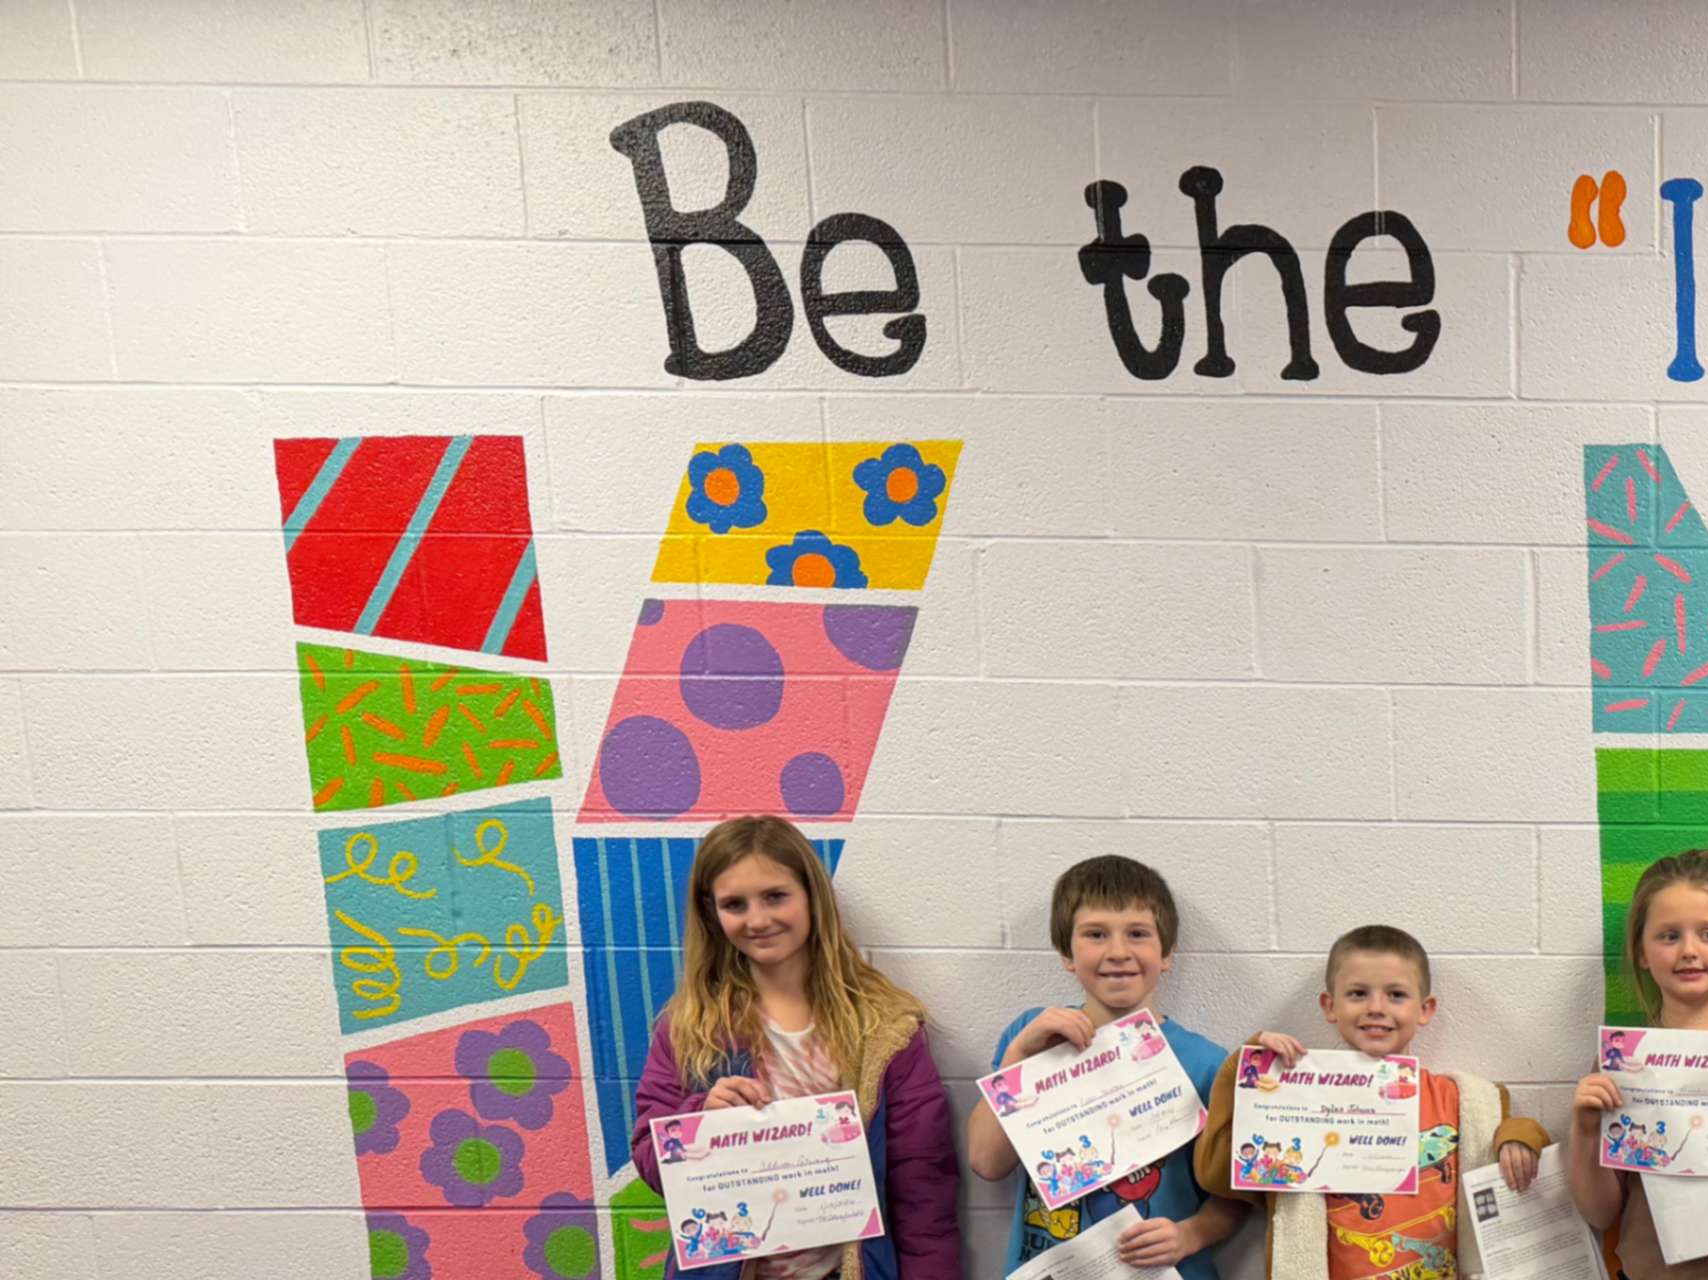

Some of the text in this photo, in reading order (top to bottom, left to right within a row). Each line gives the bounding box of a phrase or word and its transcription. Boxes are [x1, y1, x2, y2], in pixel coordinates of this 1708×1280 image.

[610, 101, 927, 379] Be
[1078, 165, 1441, 381] the
[1644, 1053, 1681, 1067] MATH
[1034, 1070, 1068, 1095] MATH
[1070, 1046, 1121, 1078] WIZARD!
[1279, 1071, 1374, 1088] MATH WIZARD!
[1129, 1086, 1182, 1118] WELL DONE!
[709, 1122, 813, 1150] MATH WIZARD!
[1656, 1121, 1665, 1135] 3
[1079, 1135, 1091, 1148] 3
[1292, 1137, 1302, 1151] 3
[1349, 1136, 1407, 1146] WELL DONE!
[799, 1179, 861, 1198] WELL DONE!
[737, 1202, 748, 1217] 3
